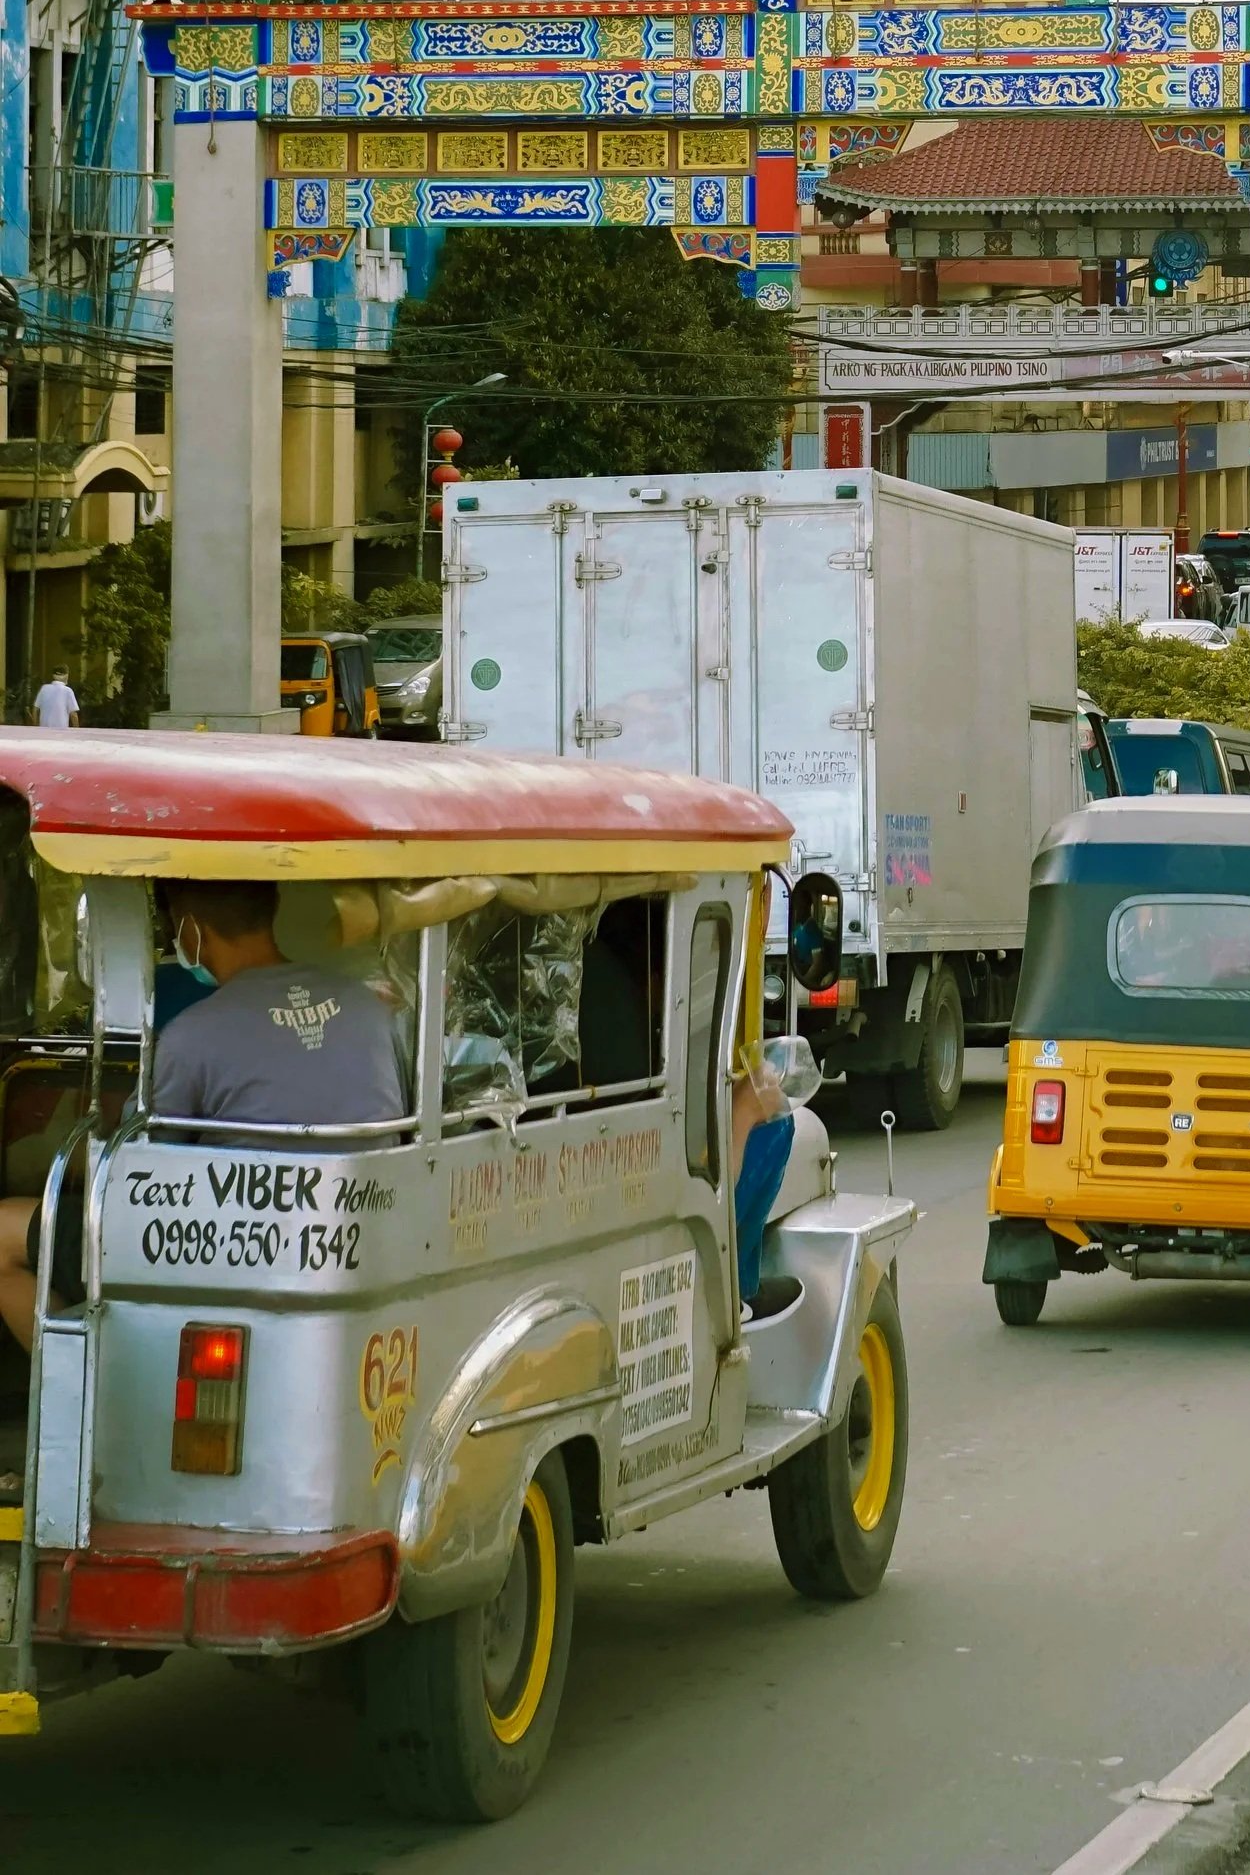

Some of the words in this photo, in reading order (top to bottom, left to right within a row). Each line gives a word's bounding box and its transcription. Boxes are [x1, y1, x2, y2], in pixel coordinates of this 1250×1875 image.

[833, 362, 861, 376] ARKO
[863, 362, 877, 376] NG
[970, 362, 1012, 376] PILIPINO
[1016, 362, 1048, 376] TSINO
[1075, 546, 1096, 556] J&T
[1129, 546, 1153, 556] J&T
[269, 998, 341, 1029] TRIBAL
[1174, 1117, 1190, 1128] RE
[126, 1170, 196, 1207] Text
[207, 1162, 322, 1212] VIBER
[677, 1259, 693, 1292] 1342
[361, 1326, 418, 1416] 621
